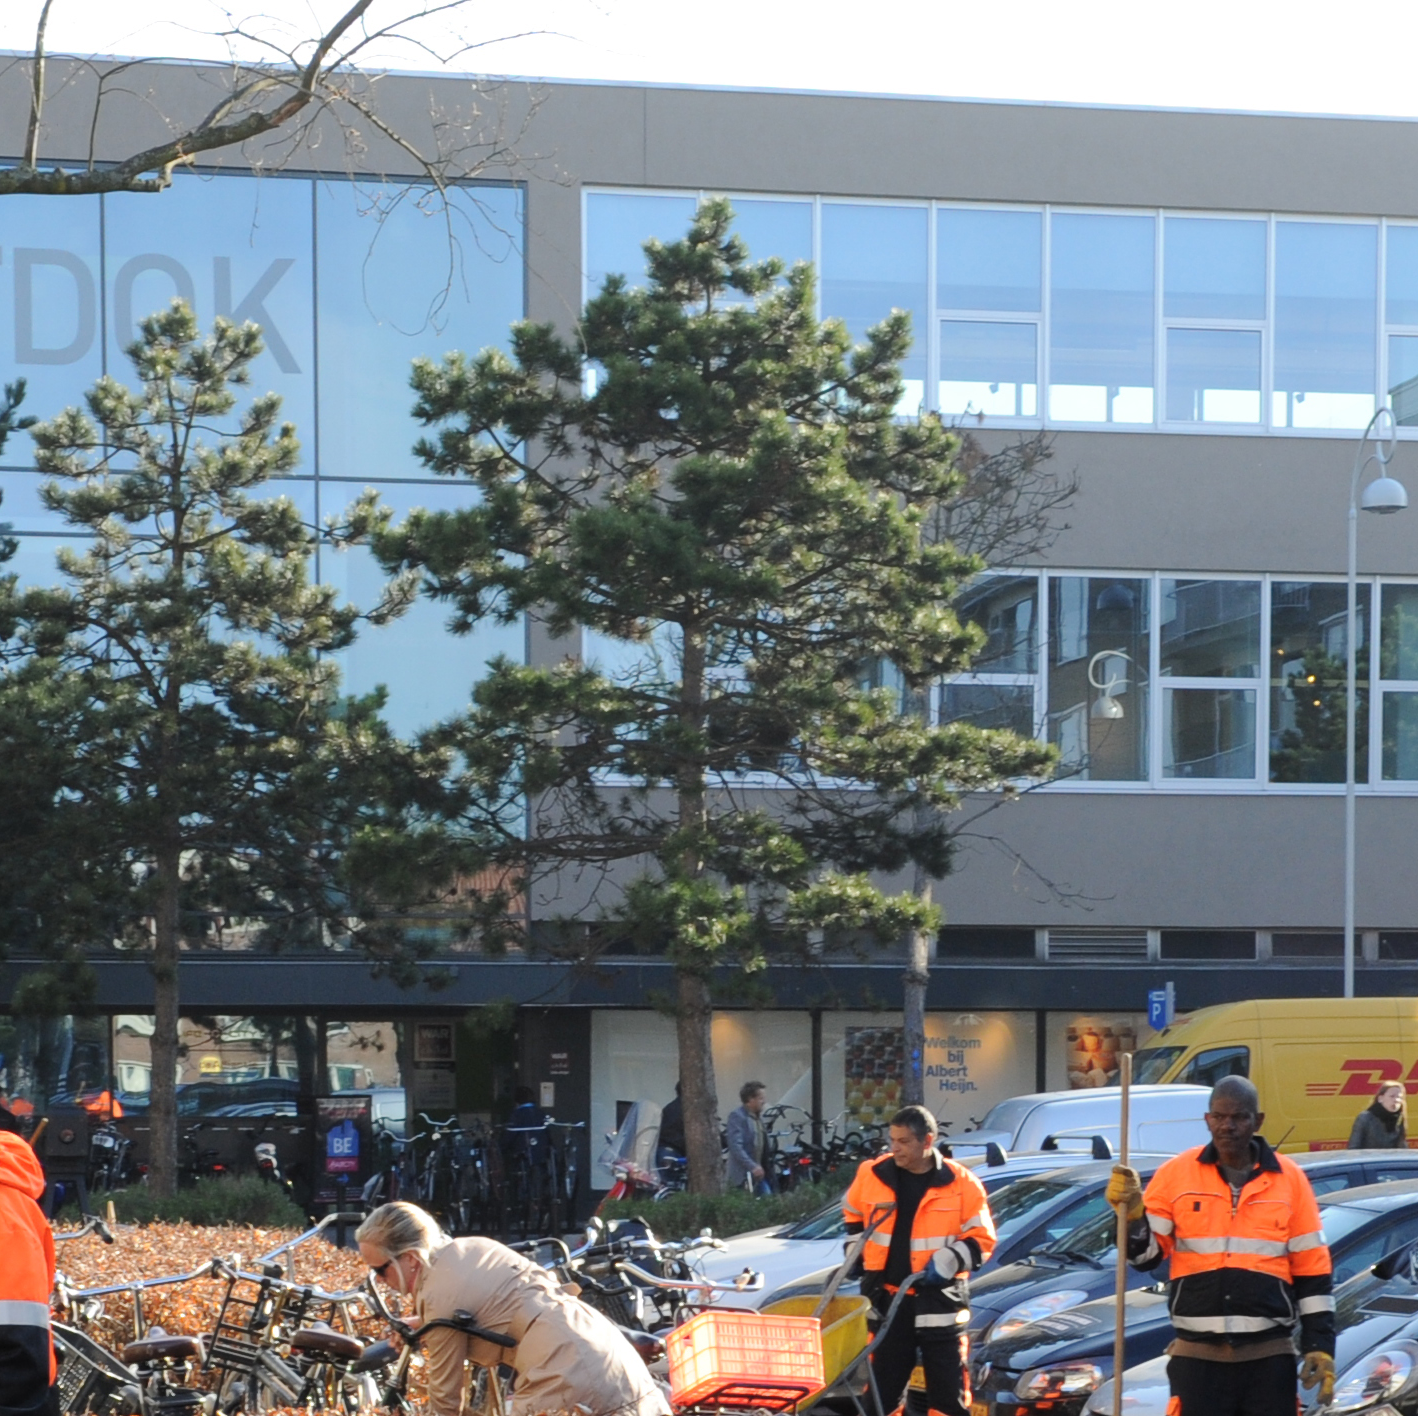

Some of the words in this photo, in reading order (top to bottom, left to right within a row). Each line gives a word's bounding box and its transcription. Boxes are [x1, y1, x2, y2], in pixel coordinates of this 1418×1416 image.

[925, 1036, 982, 1049] Welkom
[947, 1050, 964, 1066] bij
[925, 1065, 968, 1077] Albert
[939, 1079, 978, 1094] Heijn.
[333, 1137, 353, 1154] BE
